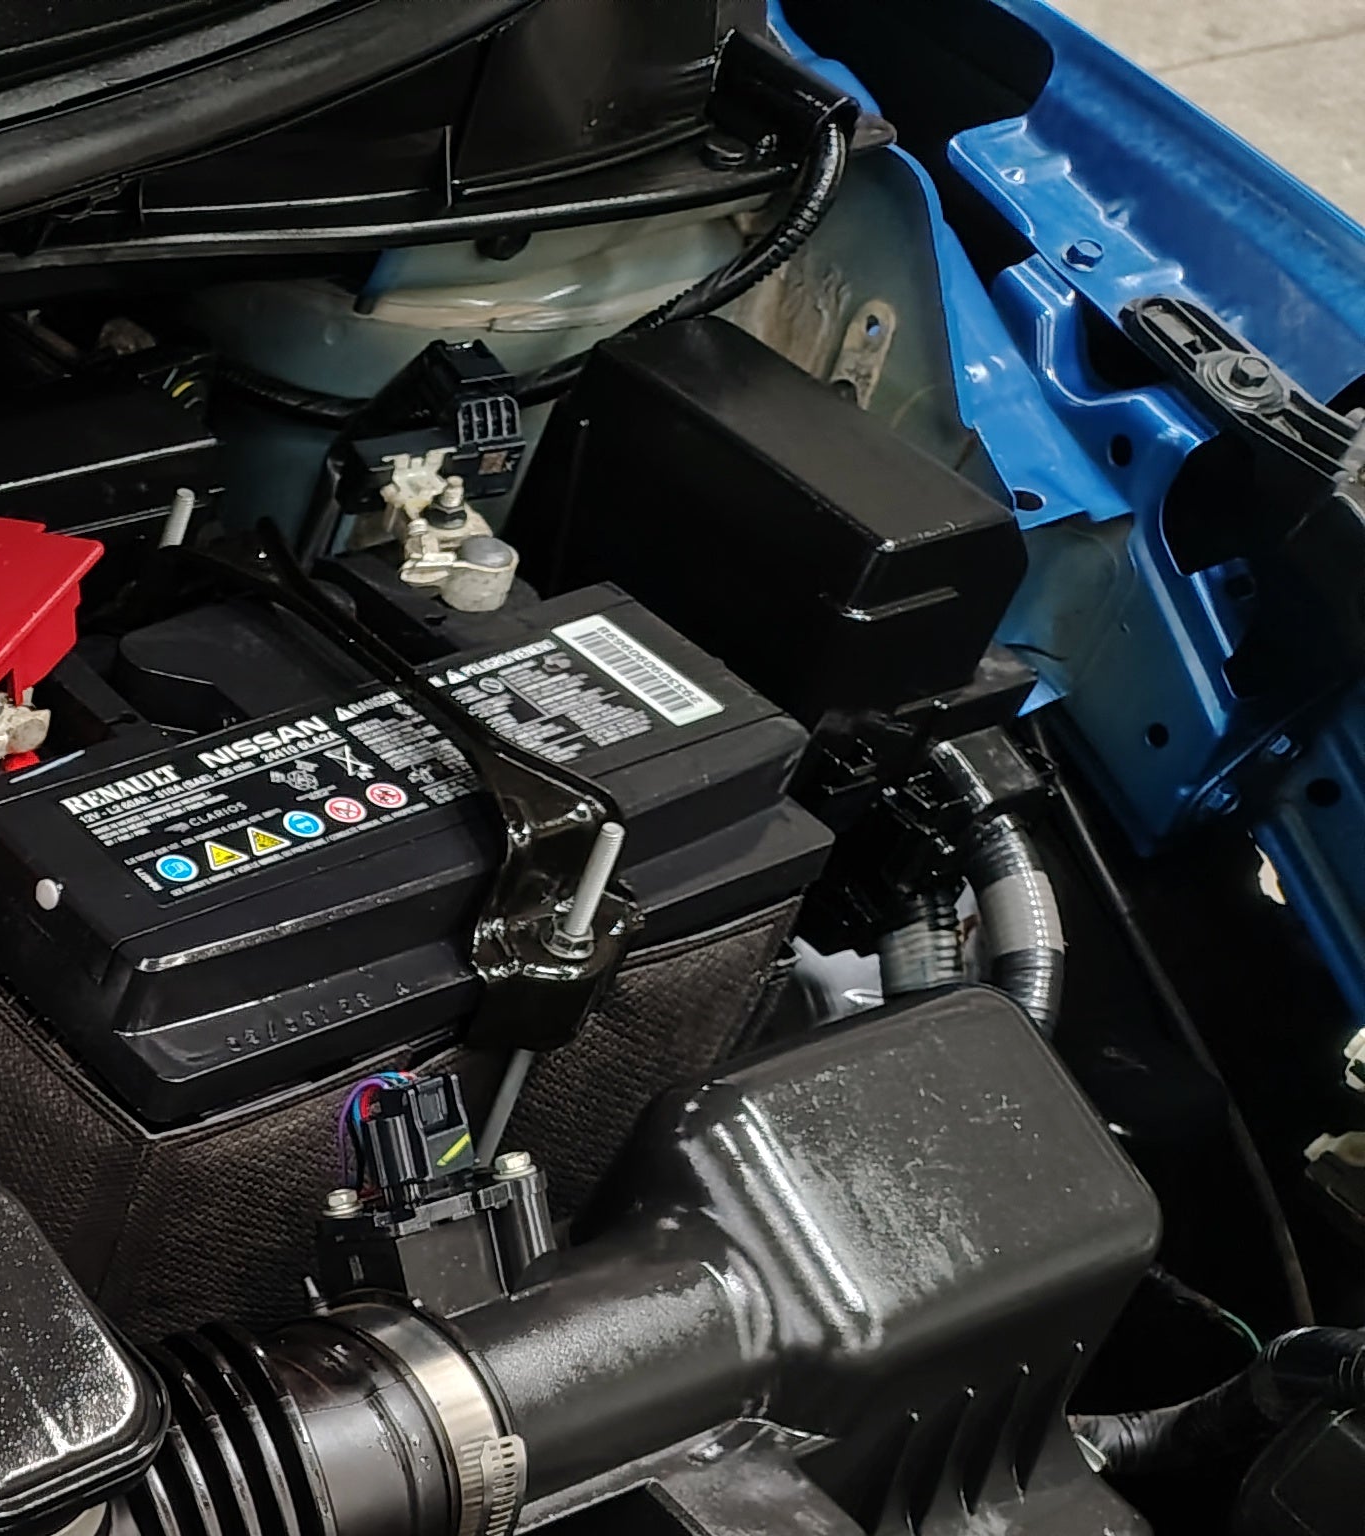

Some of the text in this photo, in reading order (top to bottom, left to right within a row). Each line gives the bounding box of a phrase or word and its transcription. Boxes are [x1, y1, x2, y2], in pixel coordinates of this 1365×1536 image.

[59, 764, 182, 815] RENAULT
[197, 715, 331, 769] NISSAN
[79, 812, 102, 825] 12V
[188, 801, 248, 828] CLARIOS
